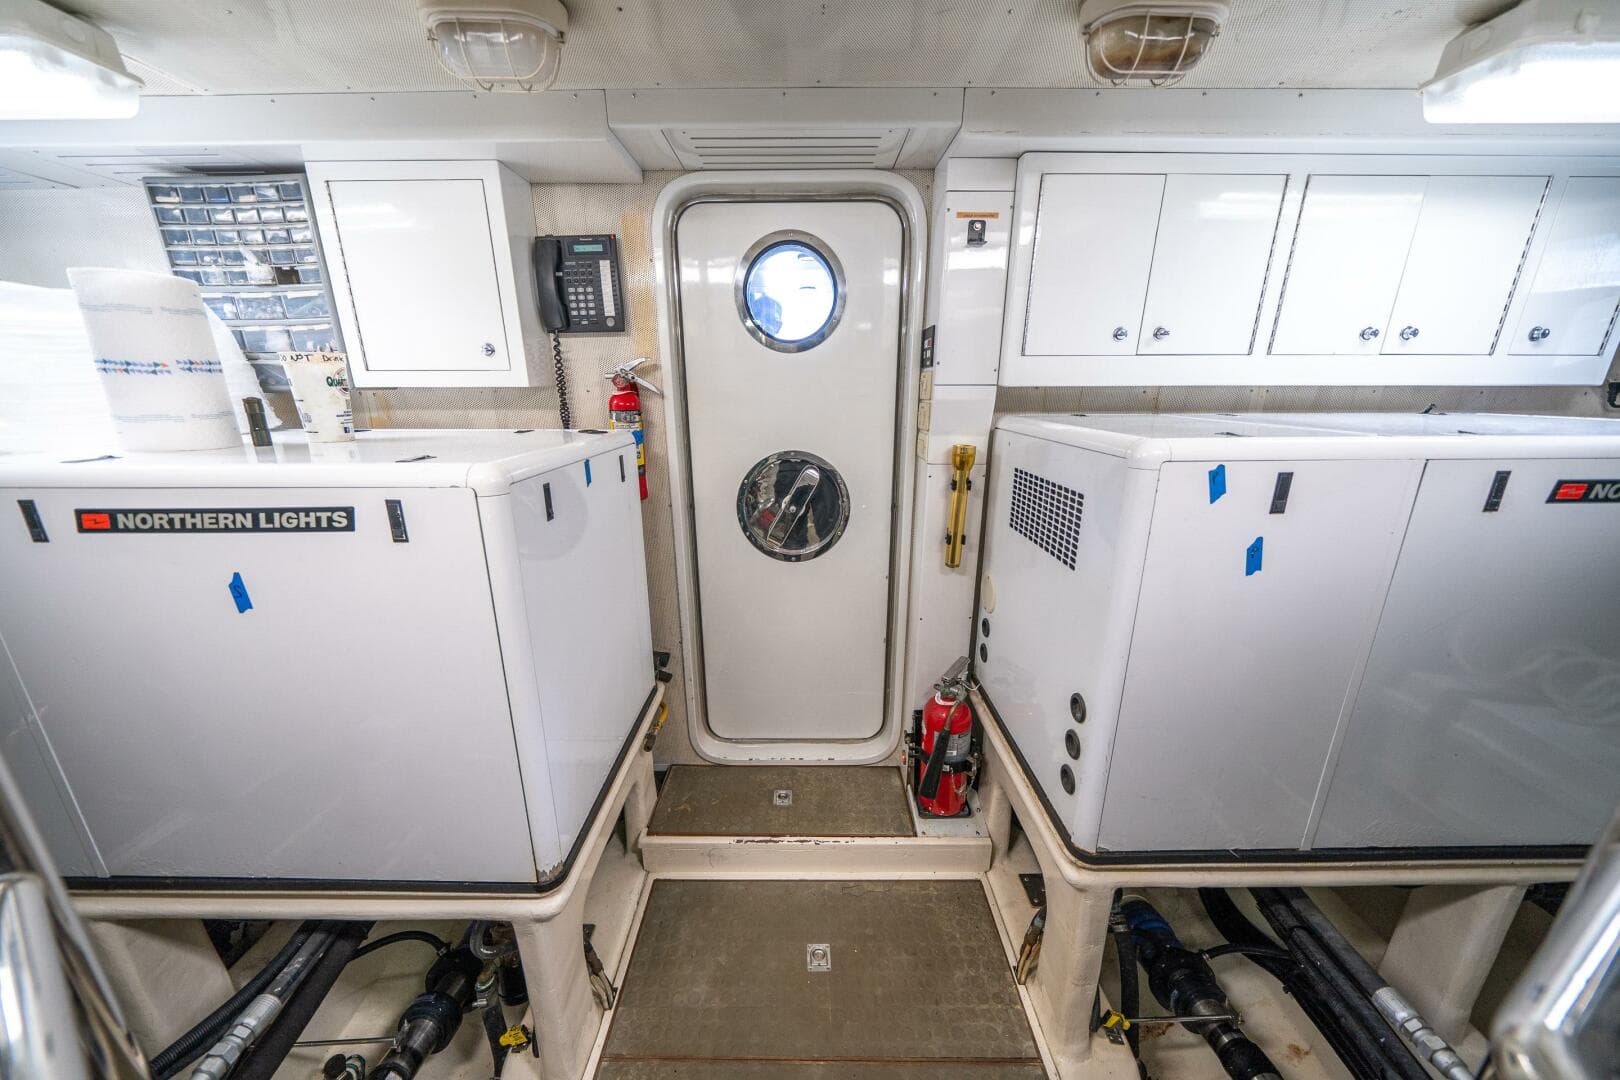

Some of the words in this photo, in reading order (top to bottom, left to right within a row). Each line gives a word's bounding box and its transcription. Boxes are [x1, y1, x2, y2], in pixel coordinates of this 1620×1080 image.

[290, 353, 313, 362] NOT
[118, 512, 253, 529] NORTHERN
[259, 511, 348, 528] LIGHTS
